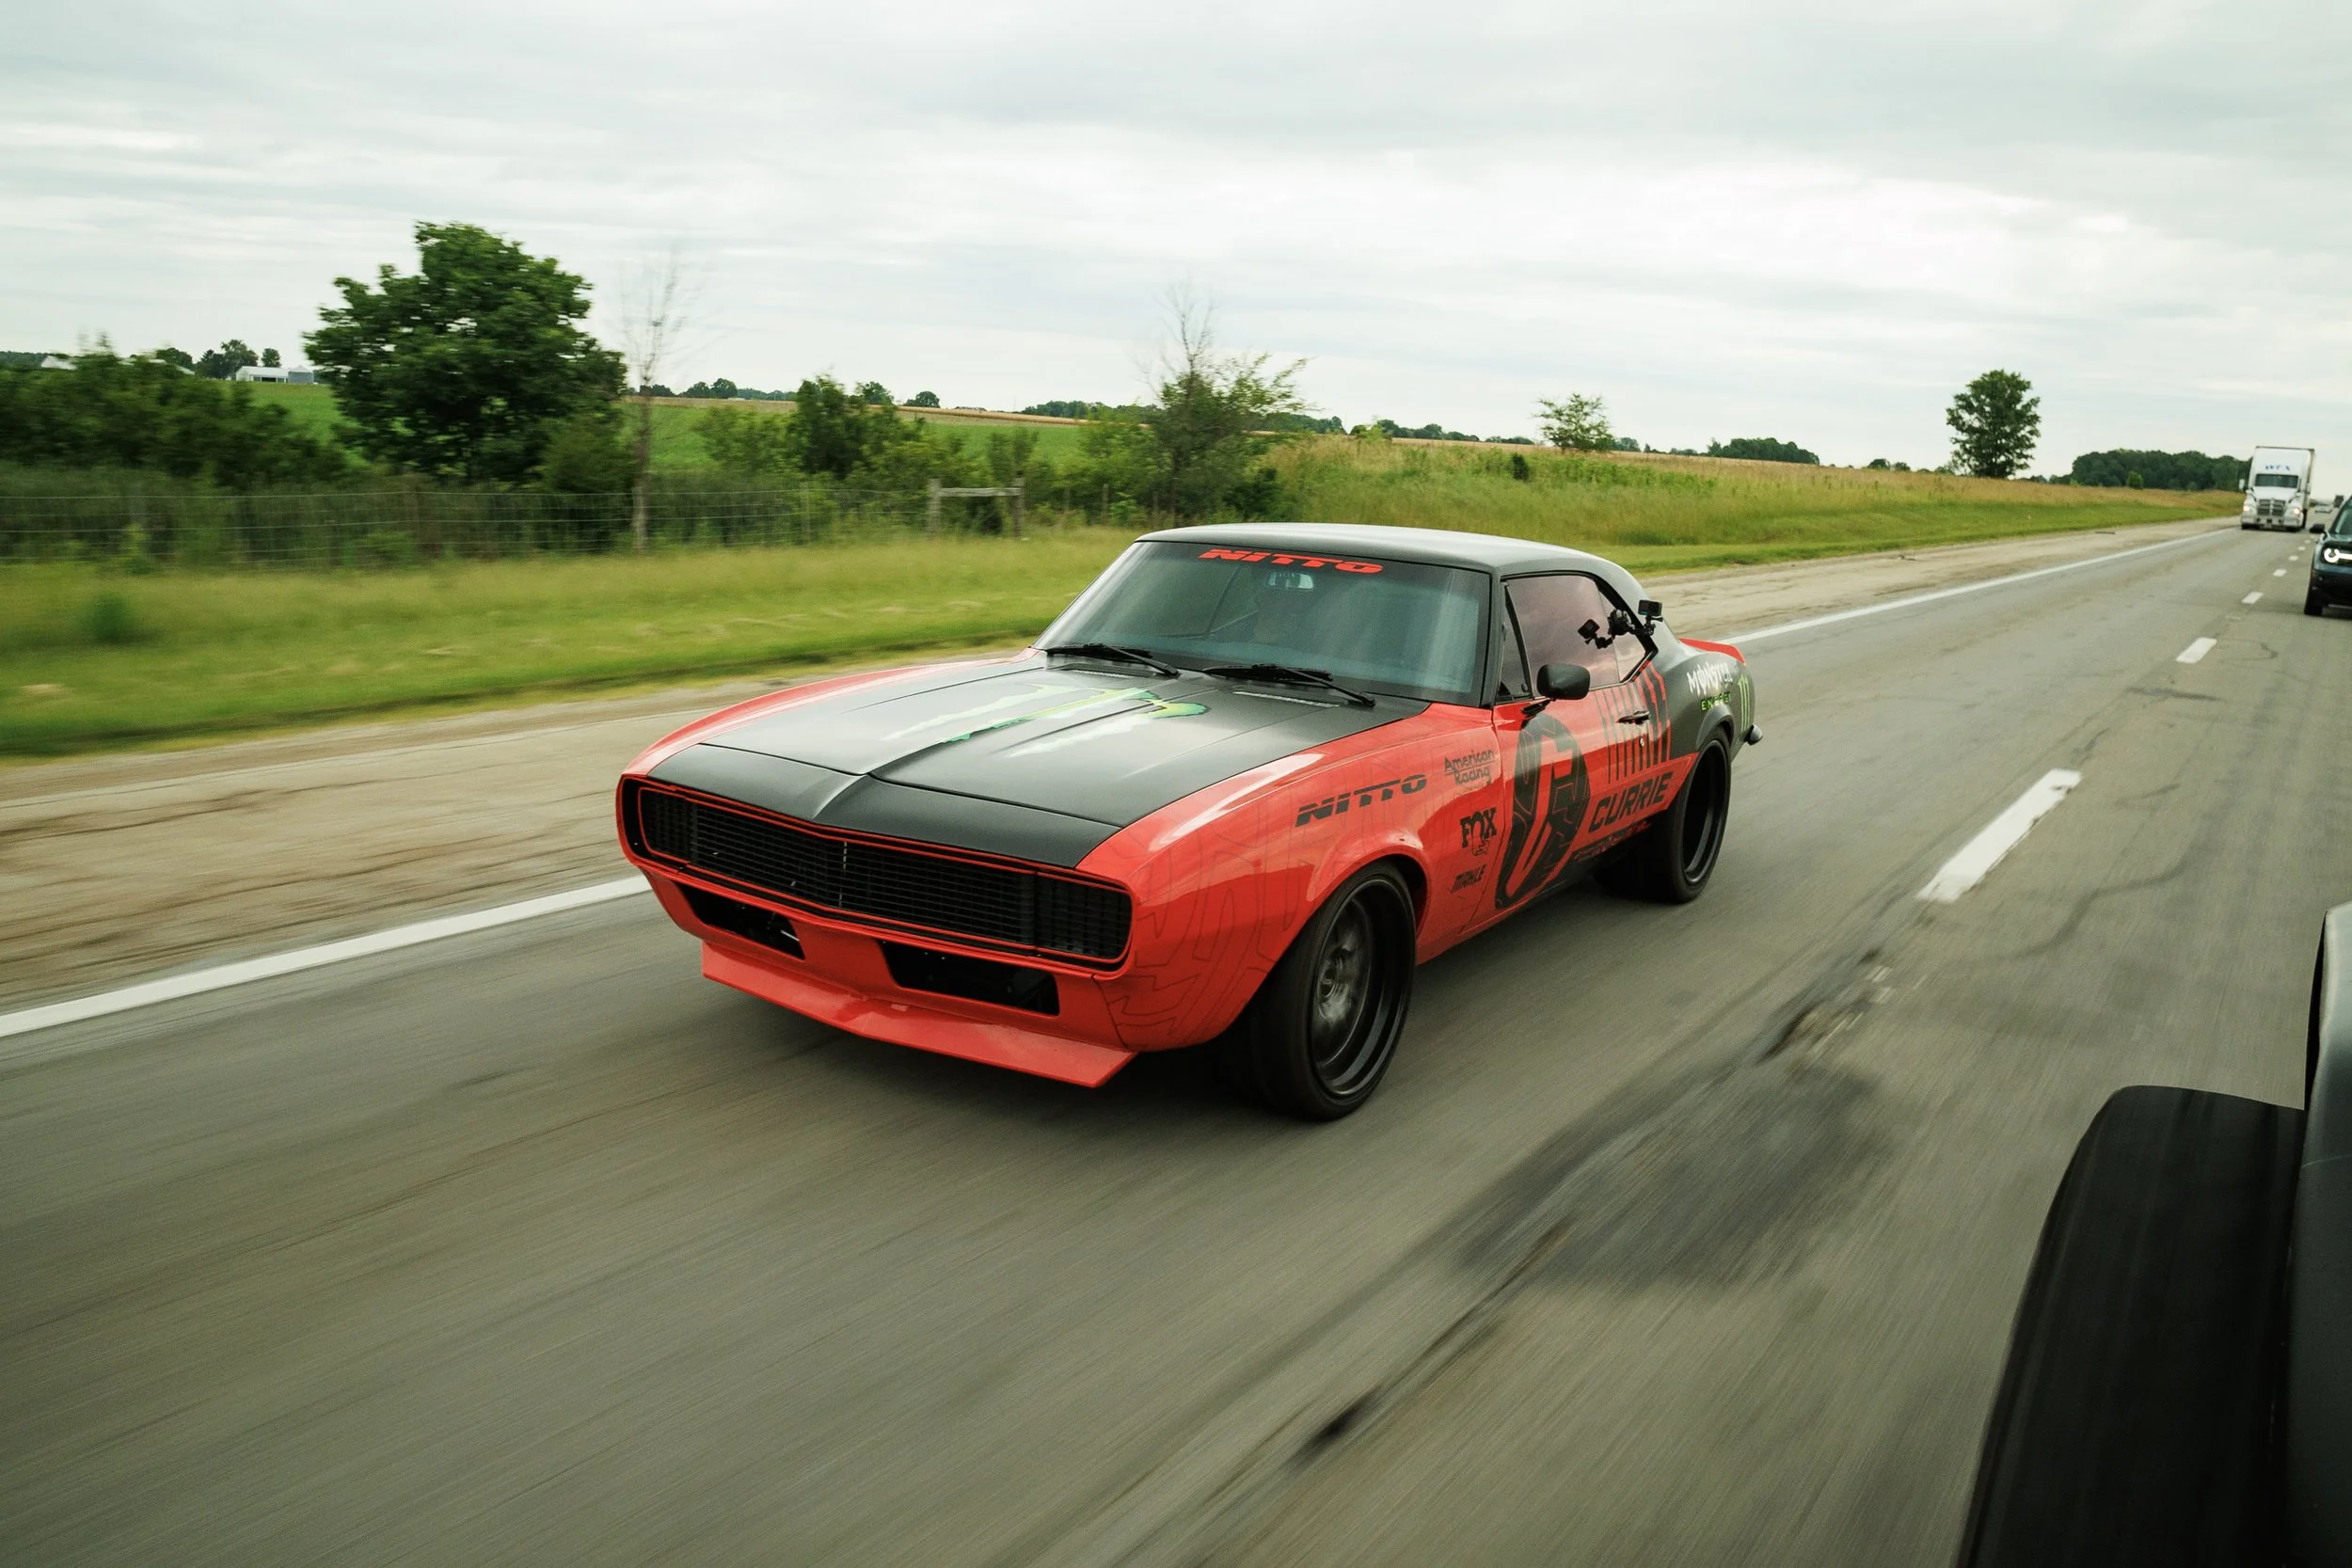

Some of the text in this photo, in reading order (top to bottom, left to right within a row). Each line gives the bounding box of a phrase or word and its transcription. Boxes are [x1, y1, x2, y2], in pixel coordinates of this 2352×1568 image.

[1198, 548, 1384, 574] NITTO
[1444, 749, 1495, 772] American
[1295, 774, 1427, 828] NITTO
[1588, 770, 1674, 833] CURRIE
[1459, 807, 1497, 849] FOX
